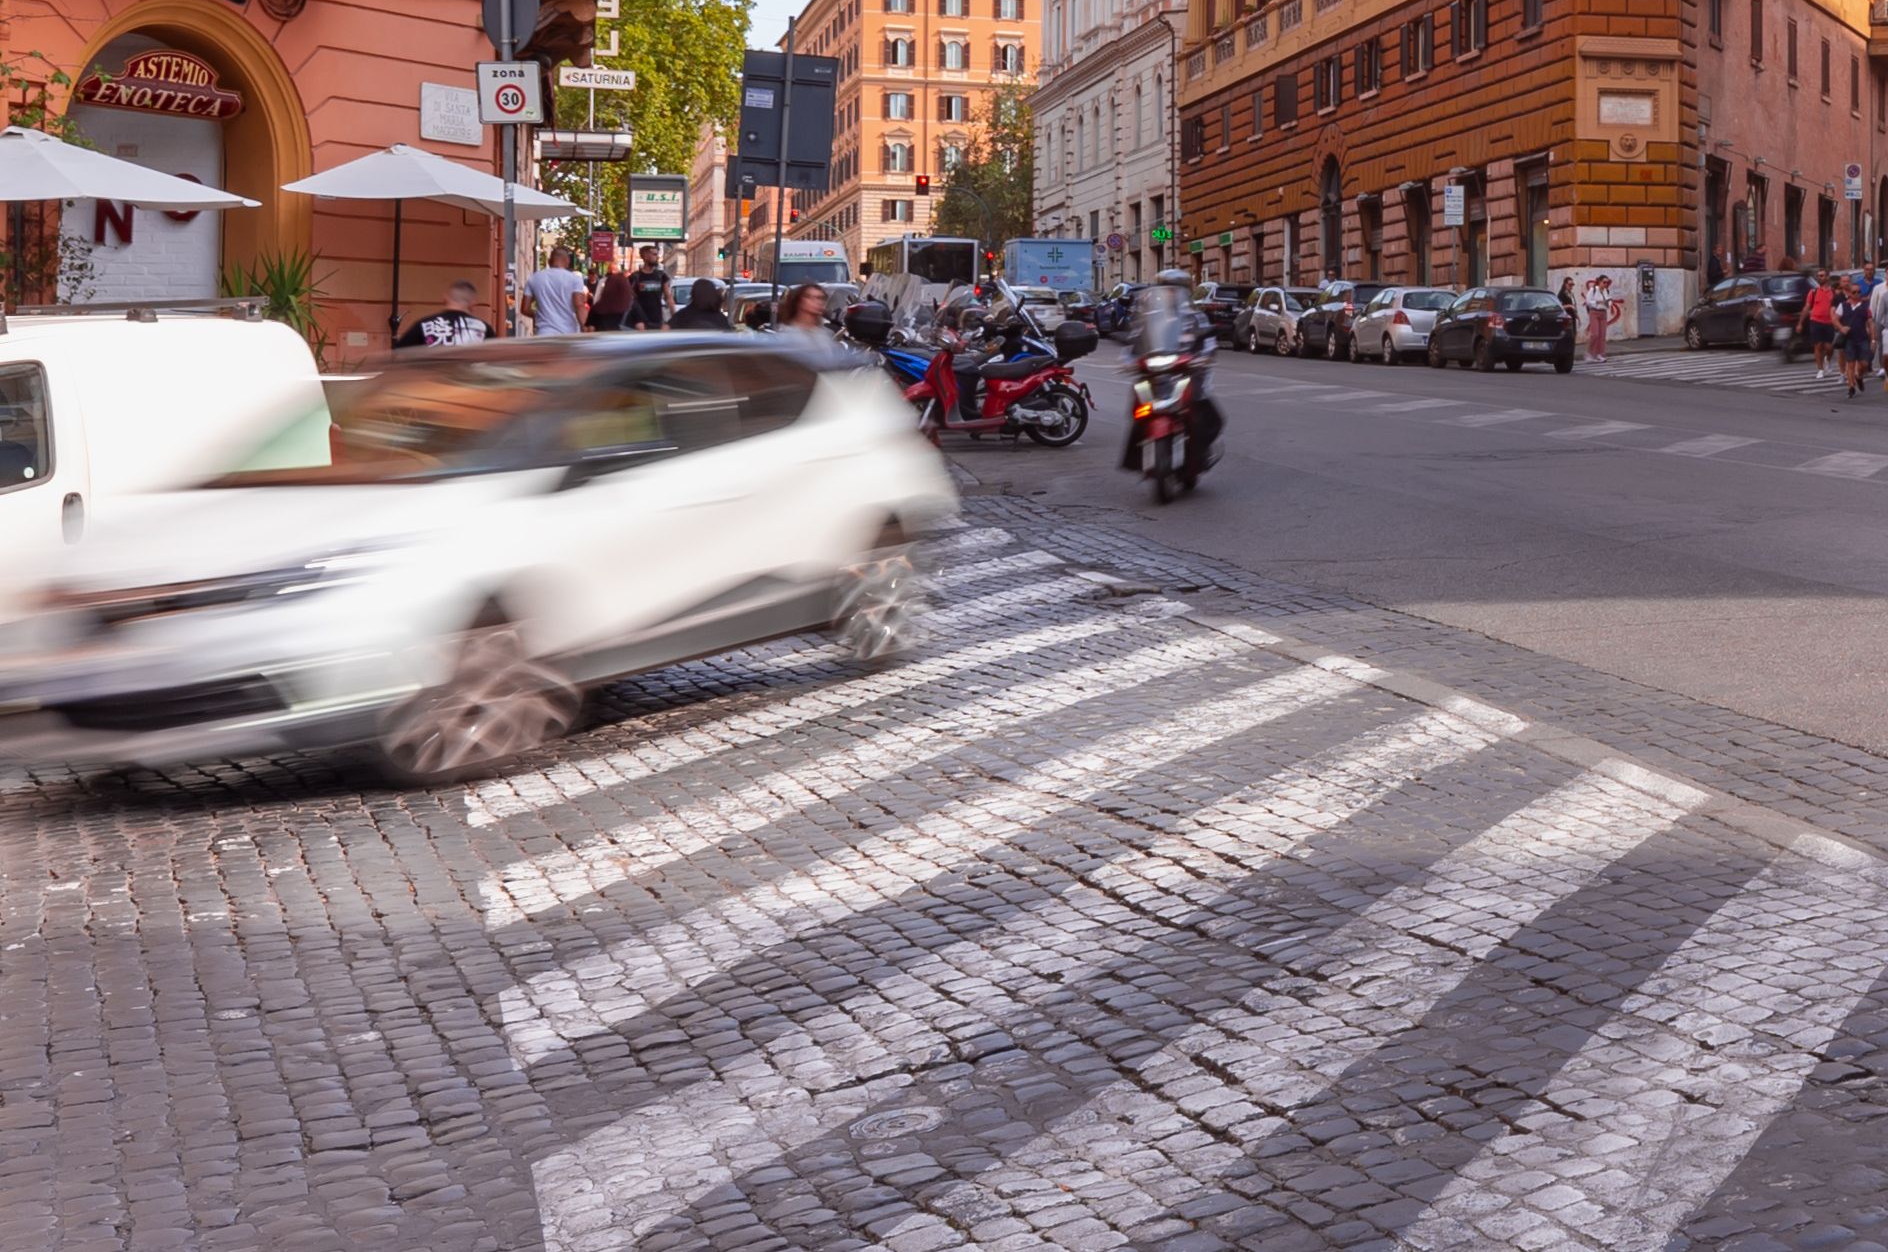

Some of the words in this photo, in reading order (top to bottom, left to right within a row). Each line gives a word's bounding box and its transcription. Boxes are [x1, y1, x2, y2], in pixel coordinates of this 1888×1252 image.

[134, 56, 209, 88] ASTEMIO
[492, 70, 525, 78] zona
[571, 72, 631, 86] SATURNIA
[92, 82, 223, 117] ENOTECA
[445, 91, 460, 102] VIA
[501, 92, 520, 106] 30
[445, 103, 472, 117] SANTA
[440, 114, 466, 127] MARIA
